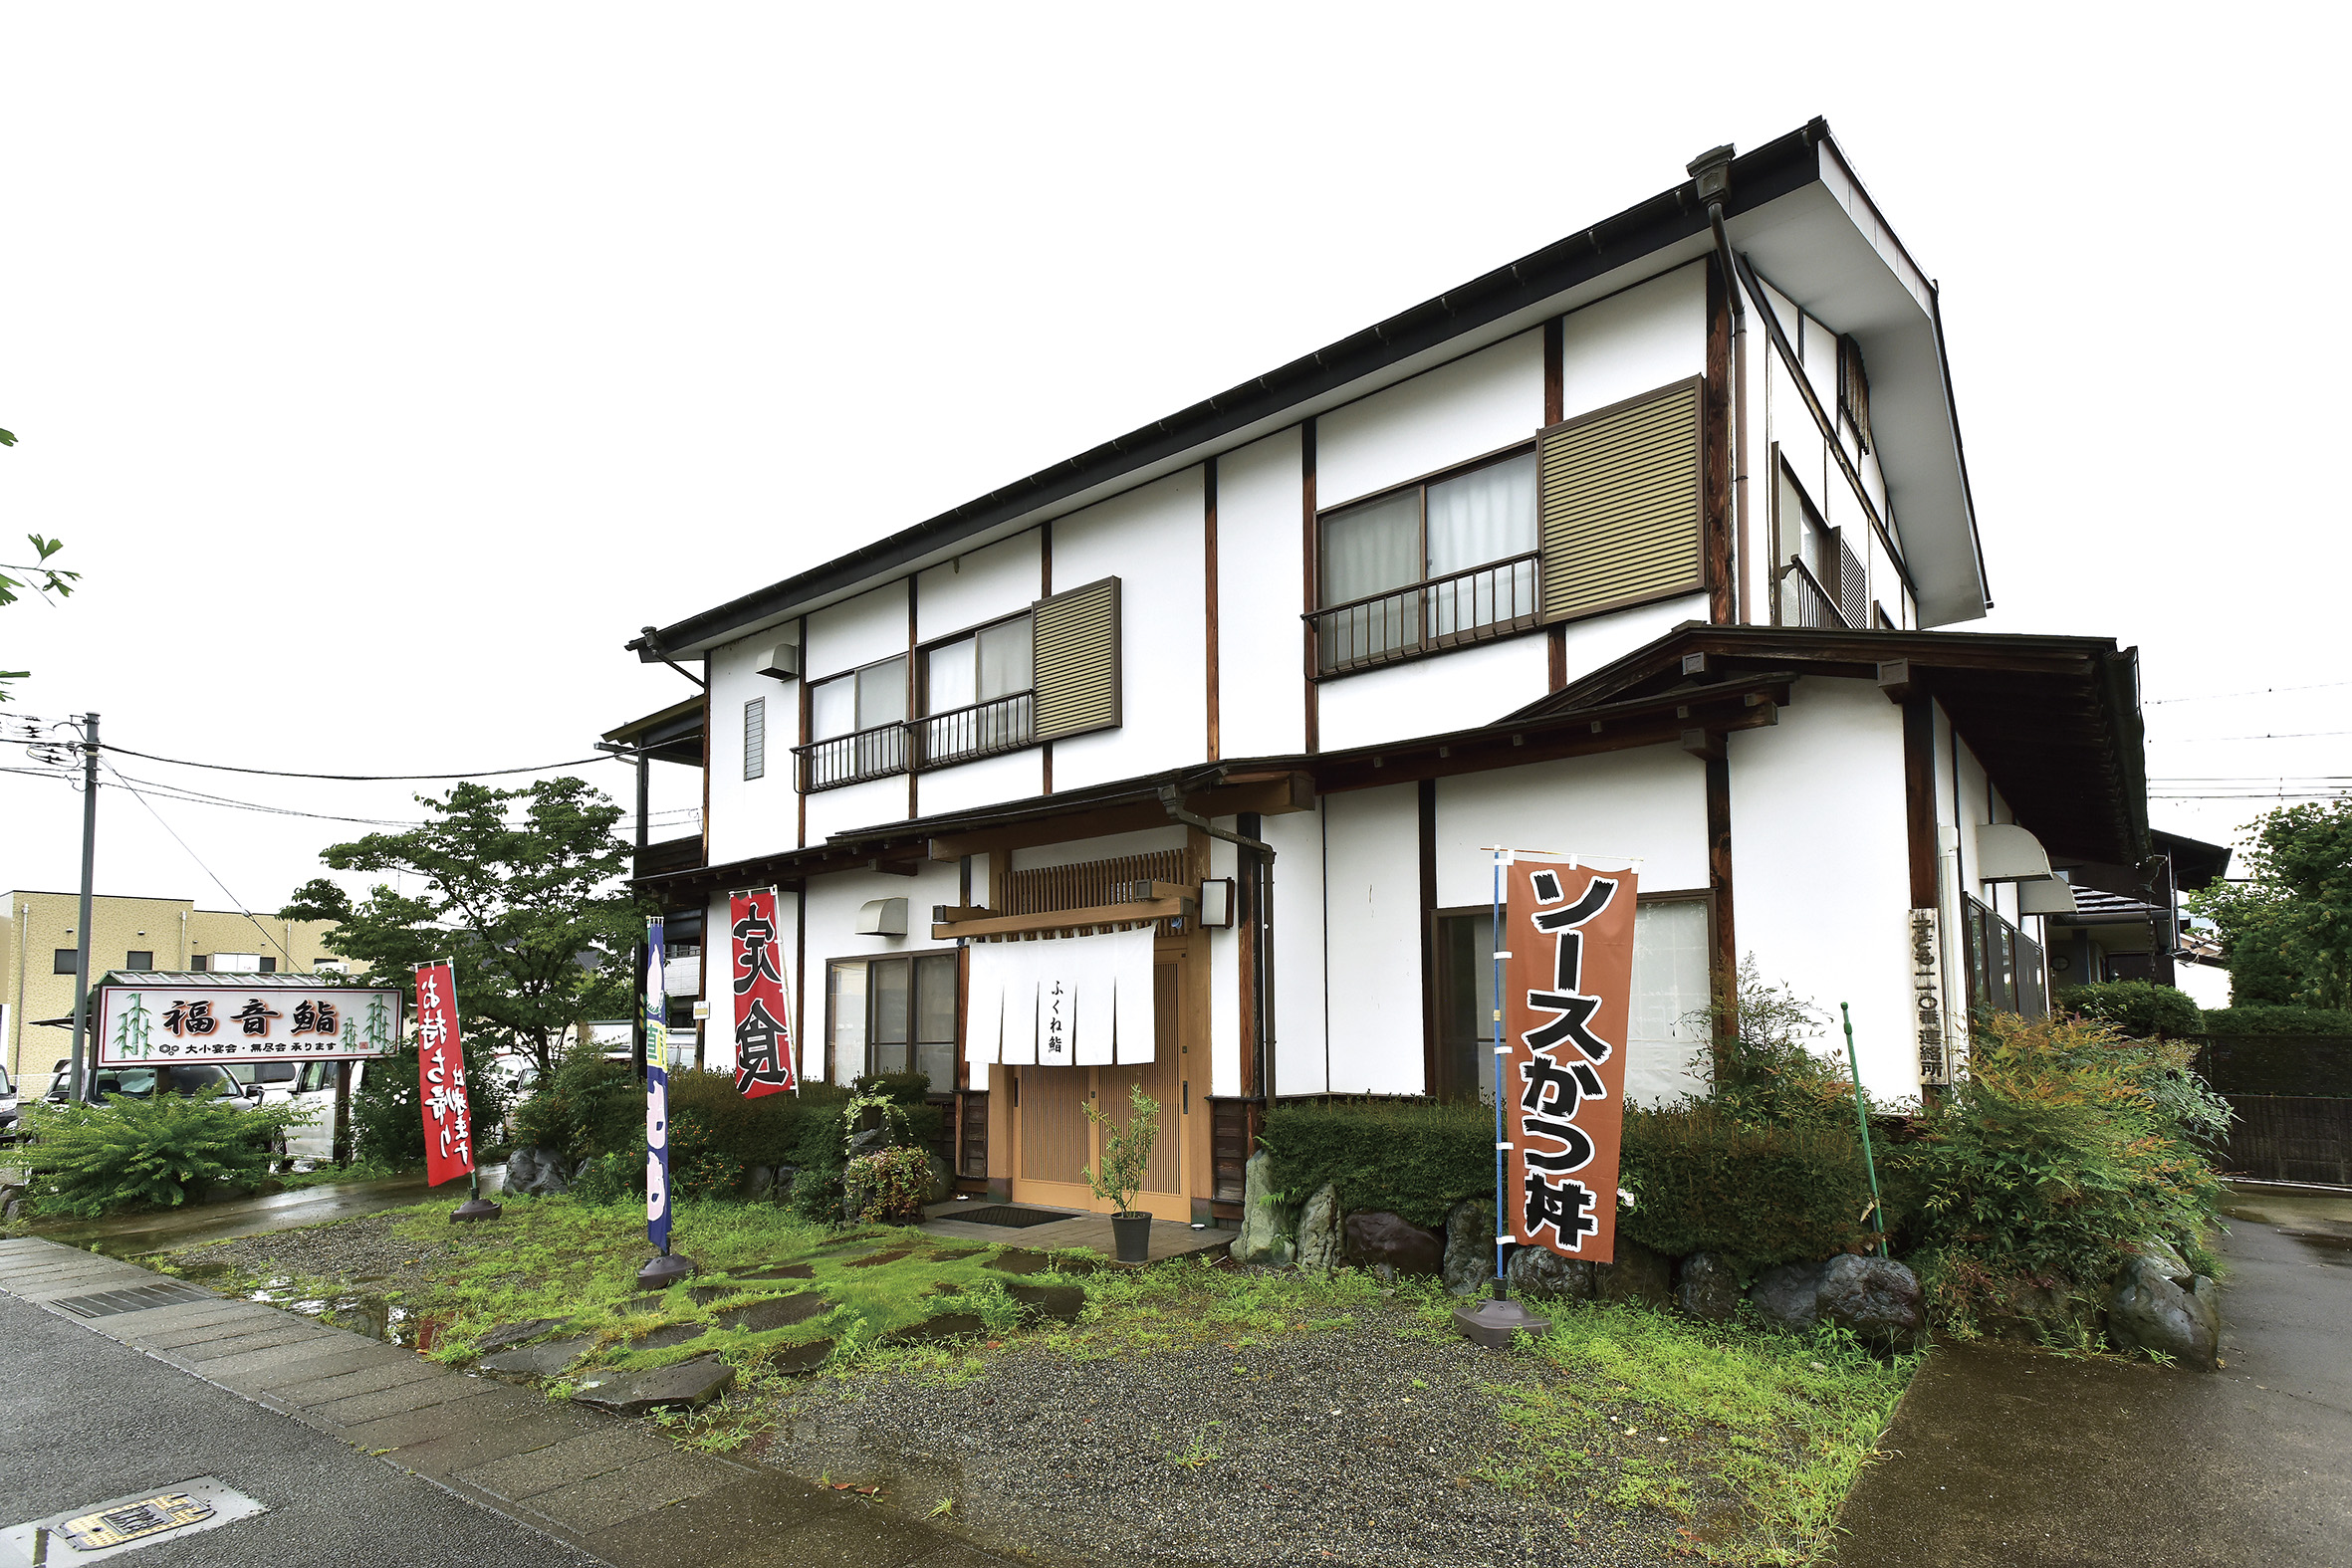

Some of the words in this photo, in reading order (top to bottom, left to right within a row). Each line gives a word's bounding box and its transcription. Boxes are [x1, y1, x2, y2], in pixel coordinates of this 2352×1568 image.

[161, 998, 339, 1036] 福音鮨
[1048, 980, 1063, 1053] ふくね鮨
[290, 1041, 337, 1051] 承ります
[1521, 869, 1619, 1253] ソースかつ丼
